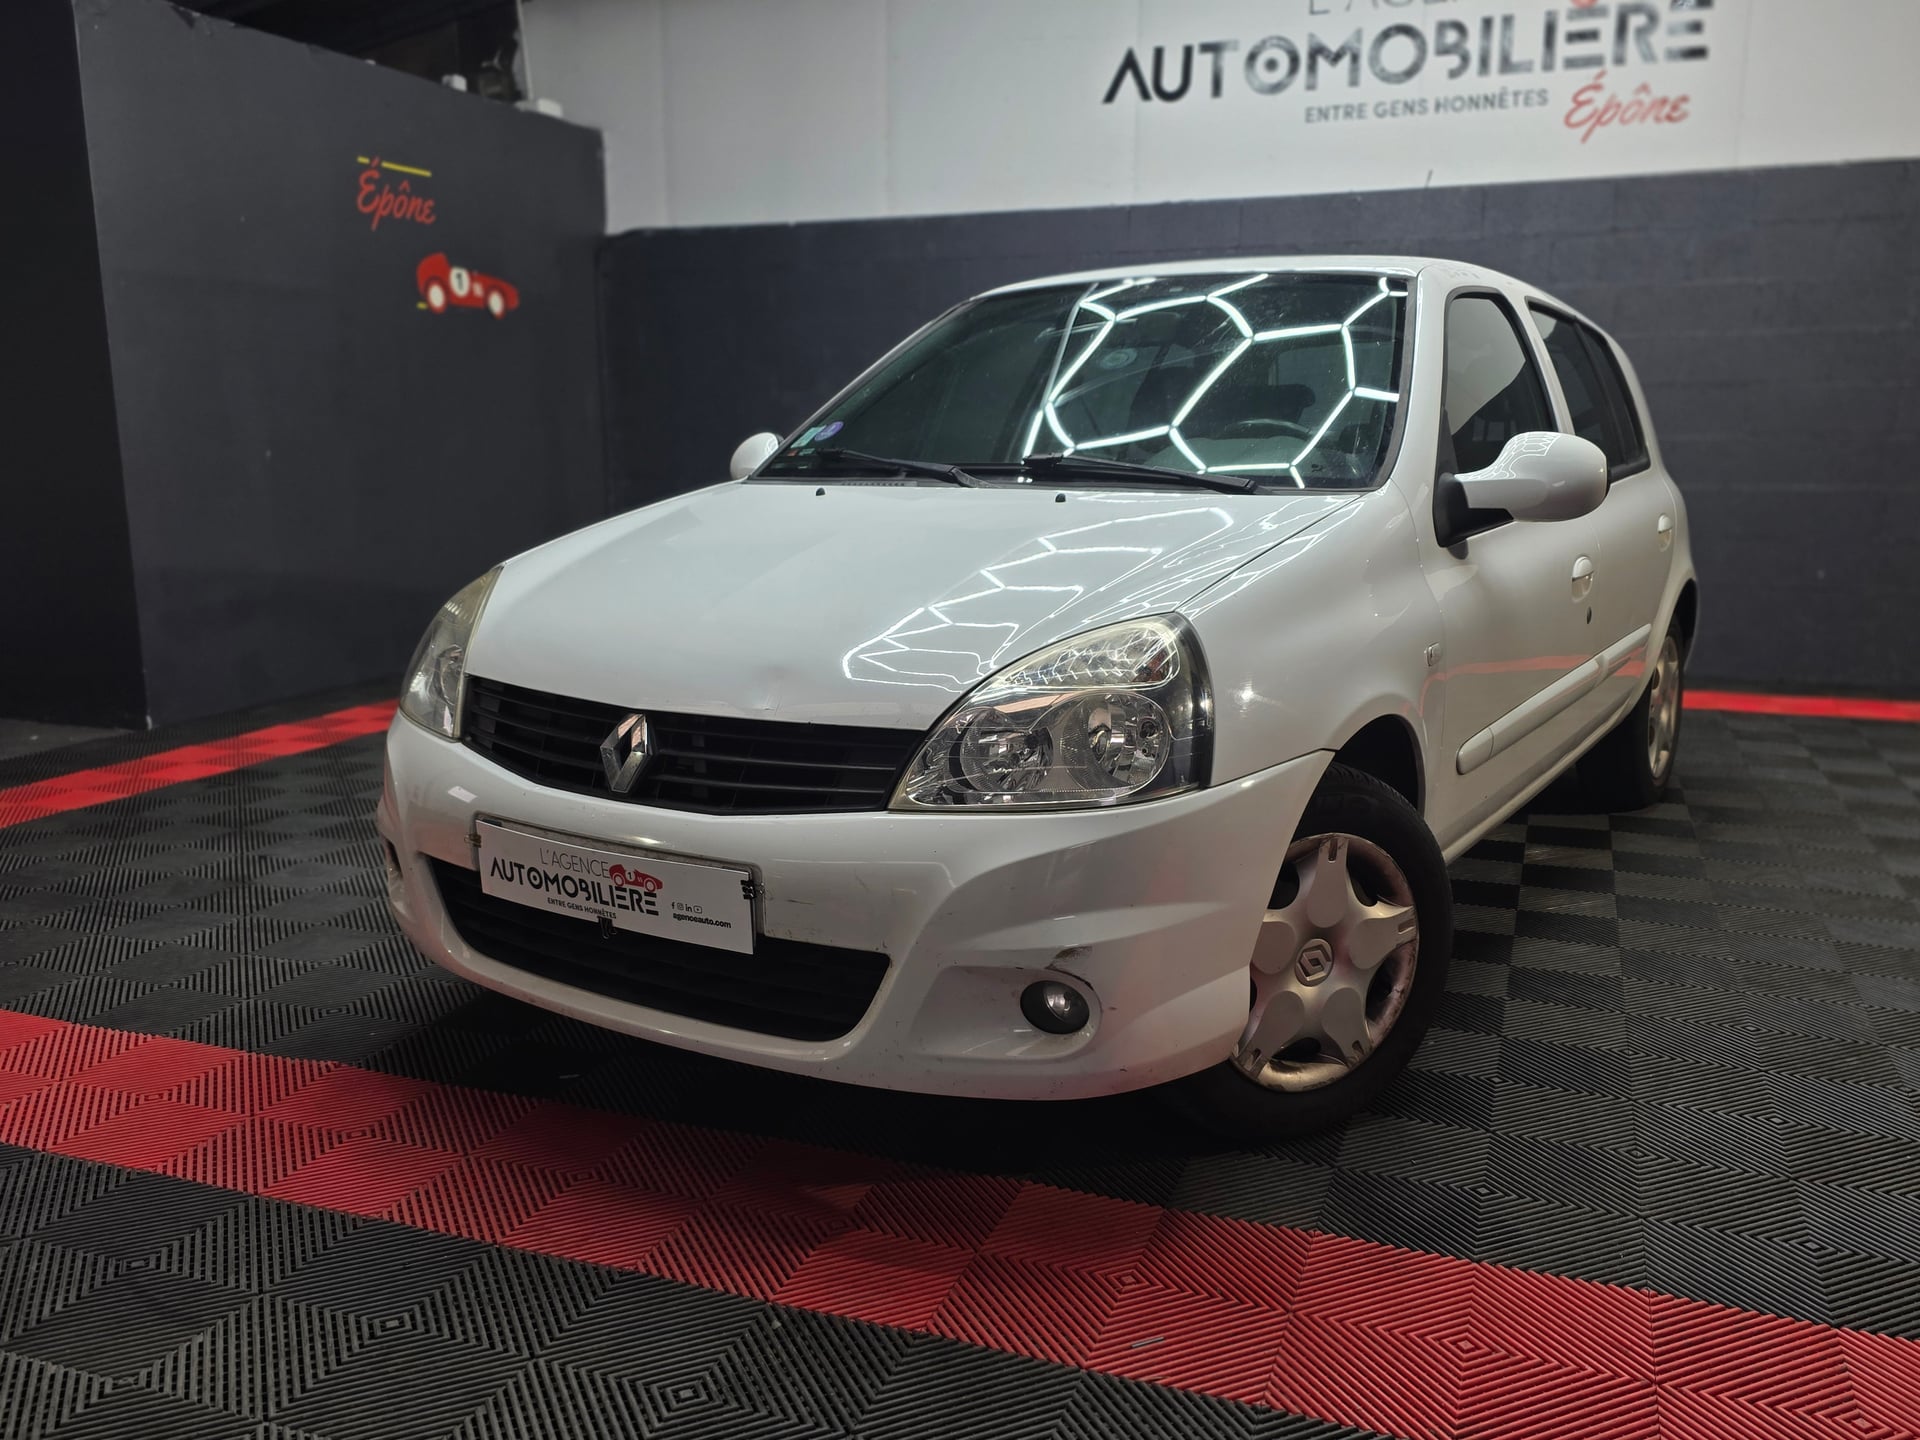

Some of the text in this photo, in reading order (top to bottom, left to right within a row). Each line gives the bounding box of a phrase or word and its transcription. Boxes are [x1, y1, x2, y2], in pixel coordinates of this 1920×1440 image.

[1305, 87, 1550, 123] ENTRE GENS HONNÊTES
[1563, 70, 1690, 144] Épône
[357, 156, 436, 232] Épône
[539, 848, 610, 879] L'AGENCE
[547, 897, 567, 908] ENTRE
[566, 902, 584, 912] GENS
[672, 912, 732, 929] agenceauto.com
